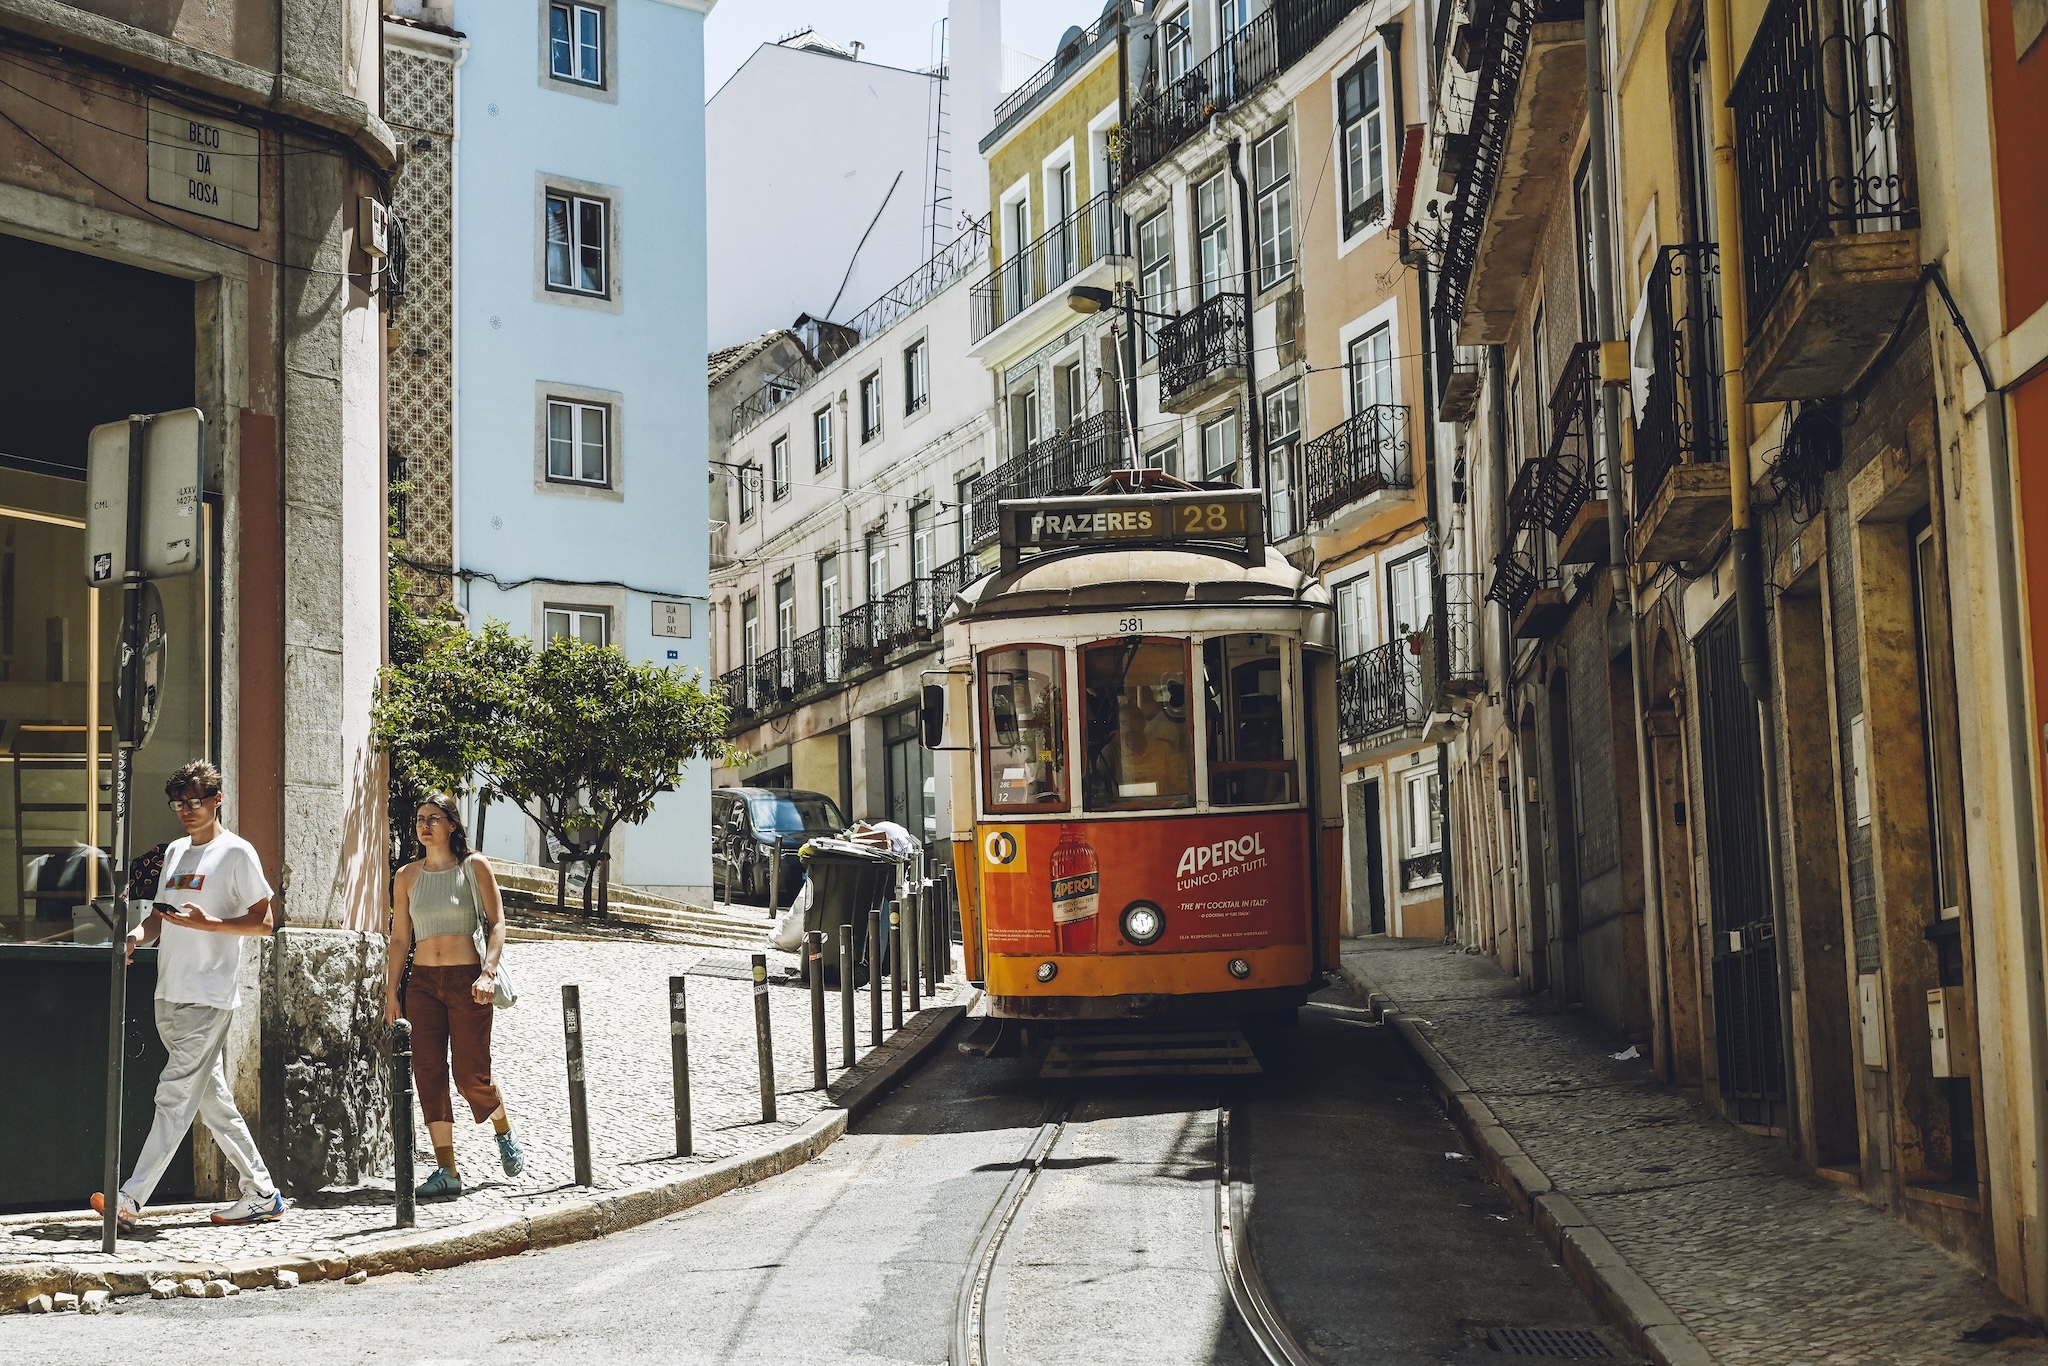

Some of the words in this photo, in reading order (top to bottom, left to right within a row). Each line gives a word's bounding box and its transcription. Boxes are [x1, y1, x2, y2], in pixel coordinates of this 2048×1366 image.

[189, 122, 220, 149] BECO
[197, 153, 211, 176] DA
[188, 179, 219, 206] ROSA
[1031, 511, 1153, 535] PRAZERES
[1183, 503, 1228, 533] 28
[666, 605, 676, 614] RUA
[666, 626, 677, 634] PAZ
[1119, 618, 1144, 632] 581
[998, 793, 1009, 802] 12
[1176, 831, 1266, 878] APEROL
[1177, 872, 1220, 891] L'UNICO.
[1222, 866, 1239, 879] PER
[1241, 857, 1268, 873] TUTTI.
[1054, 876, 1095, 898] APEROL
[1180, 903, 1195, 911] THE
[1206, 900, 1240, 910] COCKTAIL
